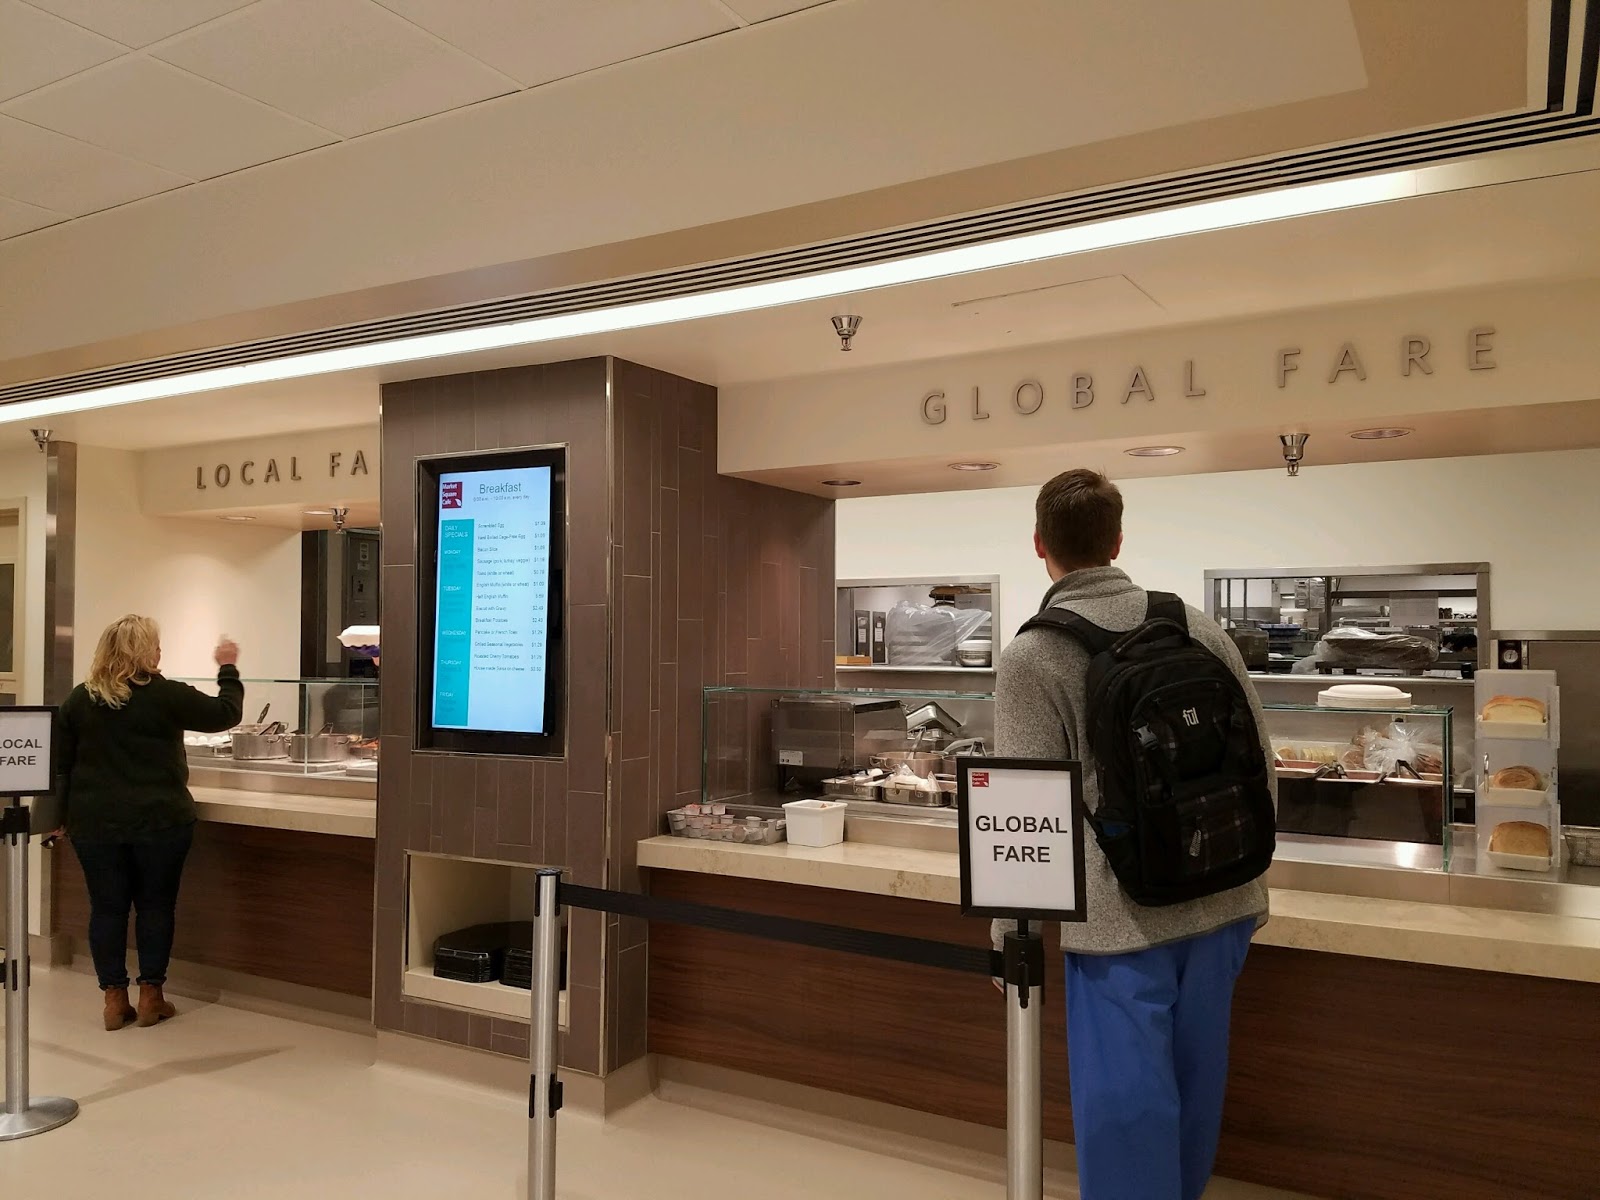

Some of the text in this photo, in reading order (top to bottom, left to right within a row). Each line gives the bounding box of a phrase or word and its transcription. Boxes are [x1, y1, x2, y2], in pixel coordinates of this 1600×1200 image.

[921, 329, 1496, 425] GLOBAL FARE
[197, 450, 368, 489] LOCAL FA
[480, 482, 521, 494] Breakfast
[0, 756, 36, 765] FARE
[976, 816, 1067, 833] GLOBAL
[993, 845, 1050, 862] FARE
